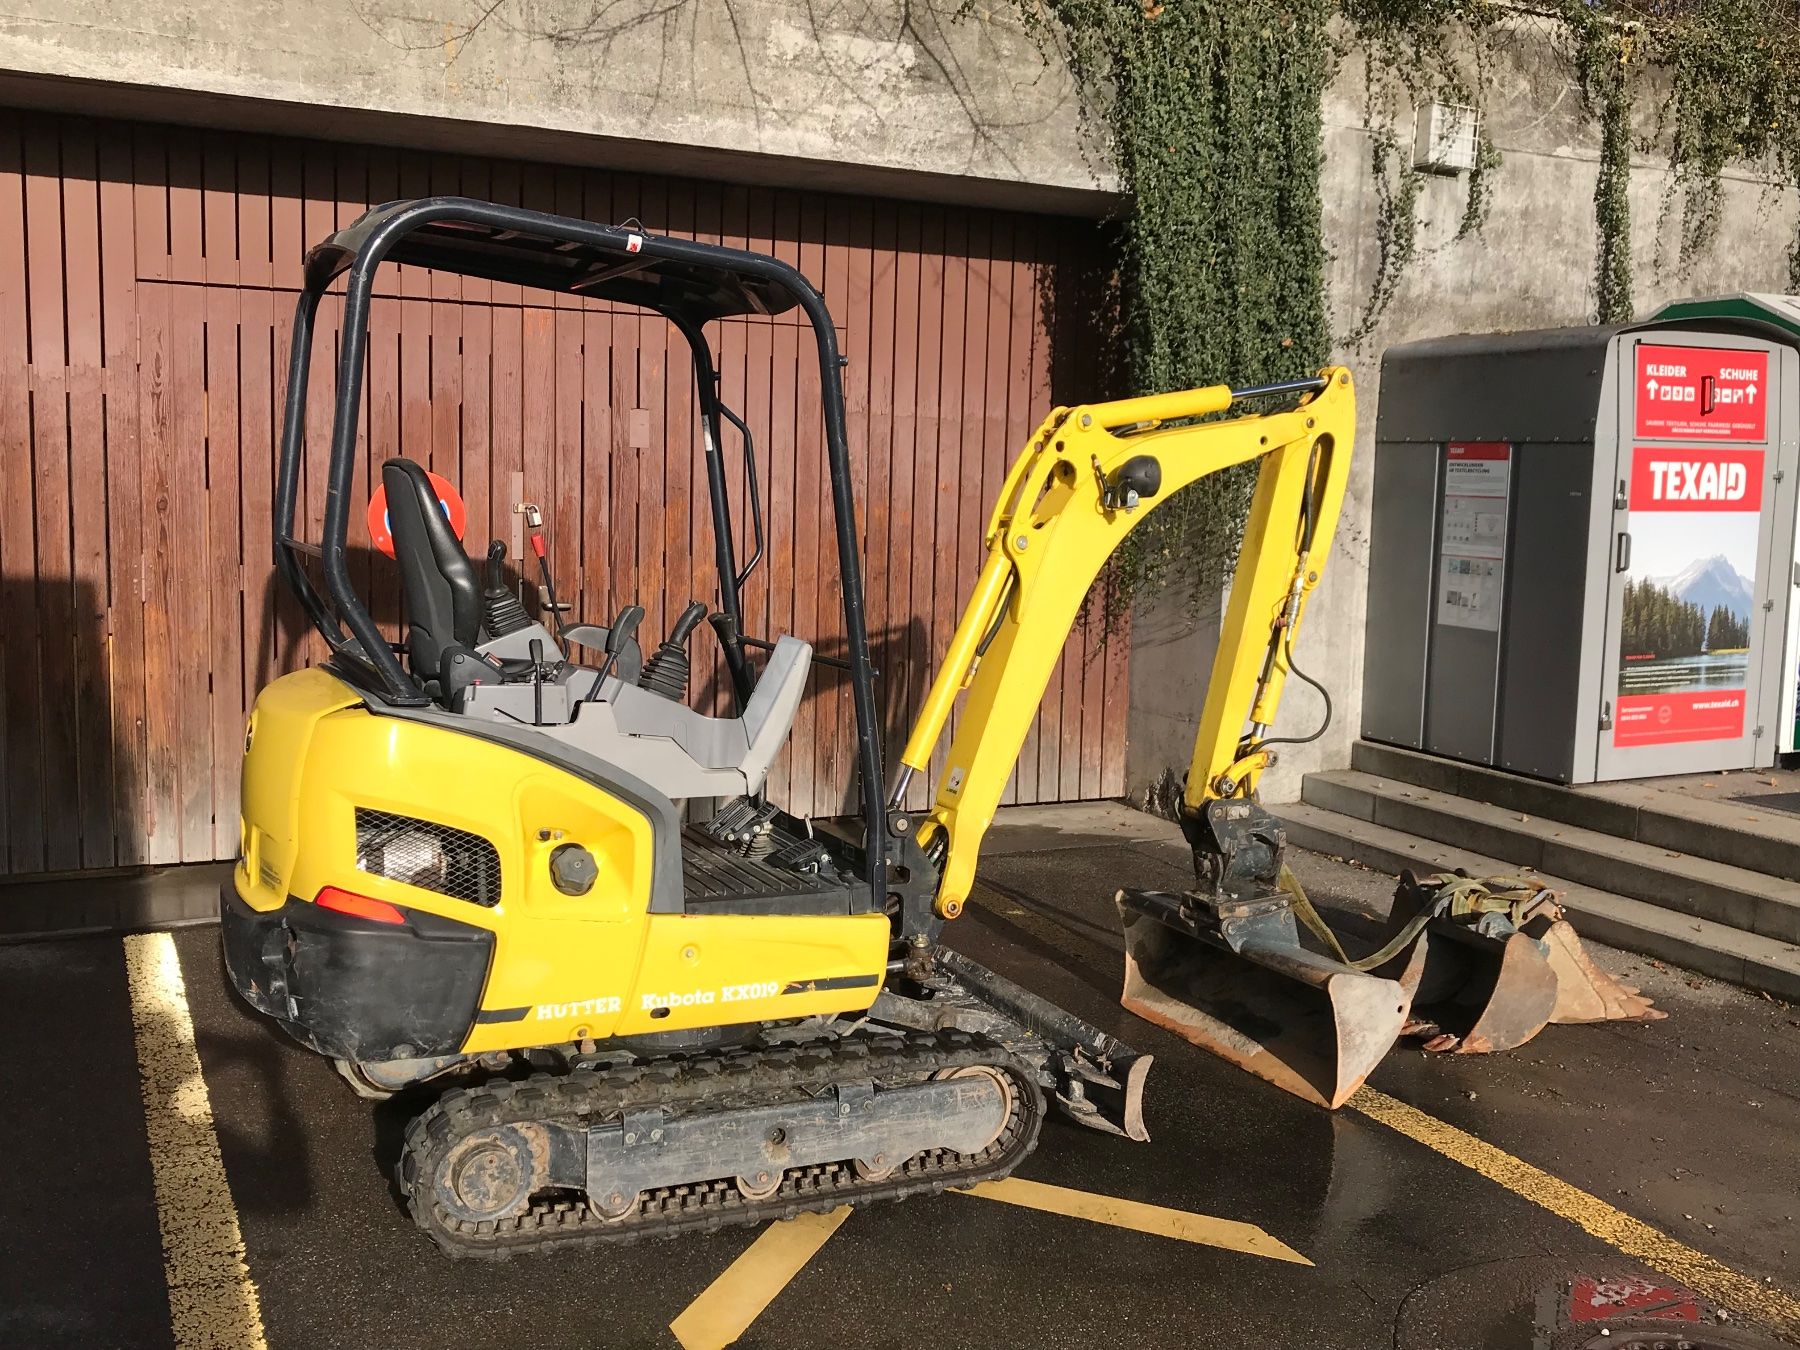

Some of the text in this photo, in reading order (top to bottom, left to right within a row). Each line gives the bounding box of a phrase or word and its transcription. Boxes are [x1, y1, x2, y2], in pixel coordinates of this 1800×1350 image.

[1646, 364, 1687, 377] KLEIDER
[1719, 368, 1758, 381] SCHUHE
[1650, 461, 1747, 501] TEXAID
[641, 982, 779, 1011] Kubota KX019
[536, 997, 622, 1020] HUTTER
